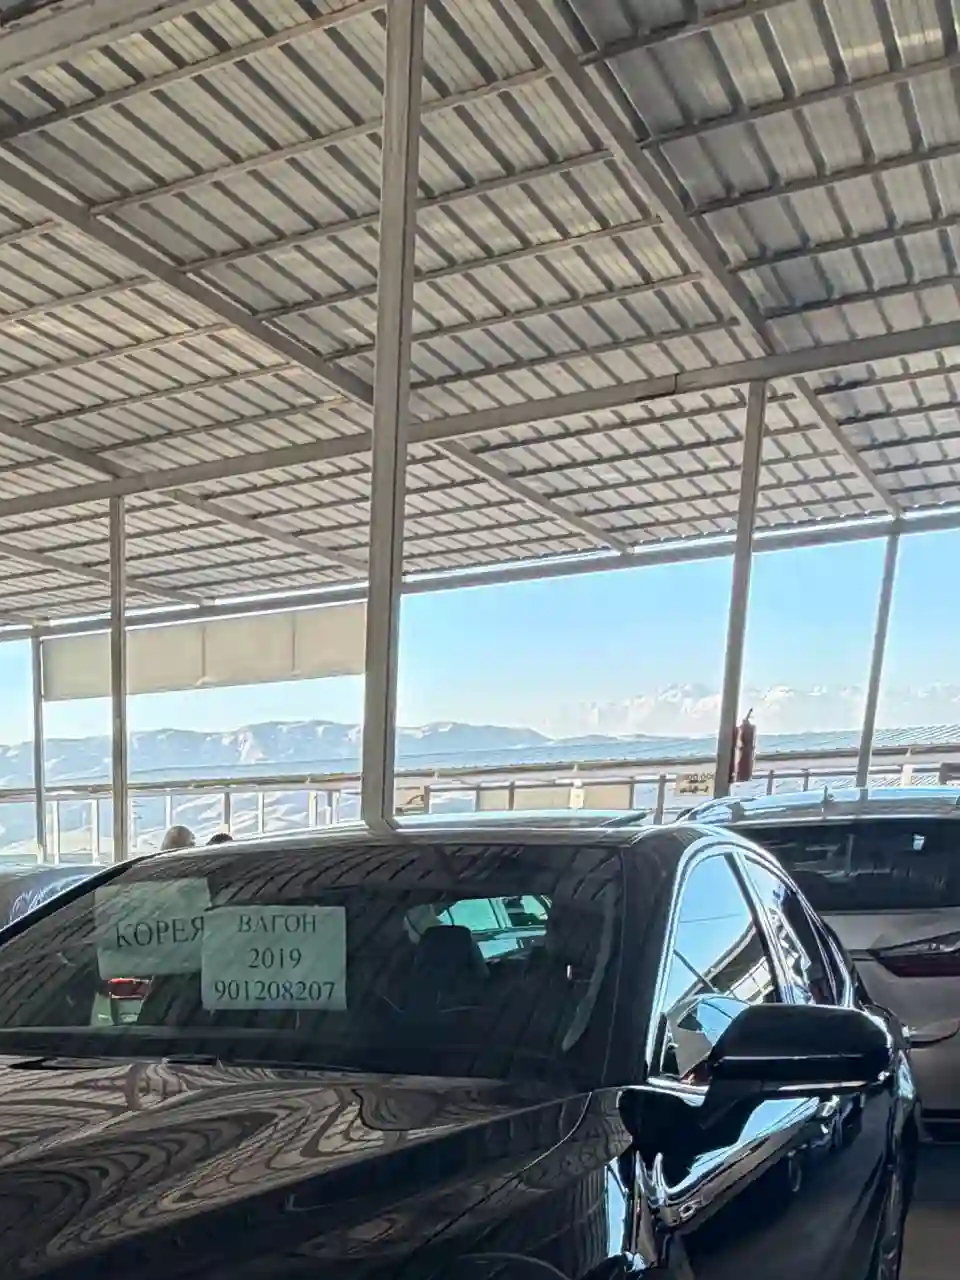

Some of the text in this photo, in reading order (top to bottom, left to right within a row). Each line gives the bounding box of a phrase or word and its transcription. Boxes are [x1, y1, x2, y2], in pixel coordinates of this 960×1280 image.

[115, 916, 205, 949] КОРЕЯ
[237, 914, 317, 934] ВАГОН
[248, 947, 302, 969] 2019
[213, 980, 336, 1001] 901208207
